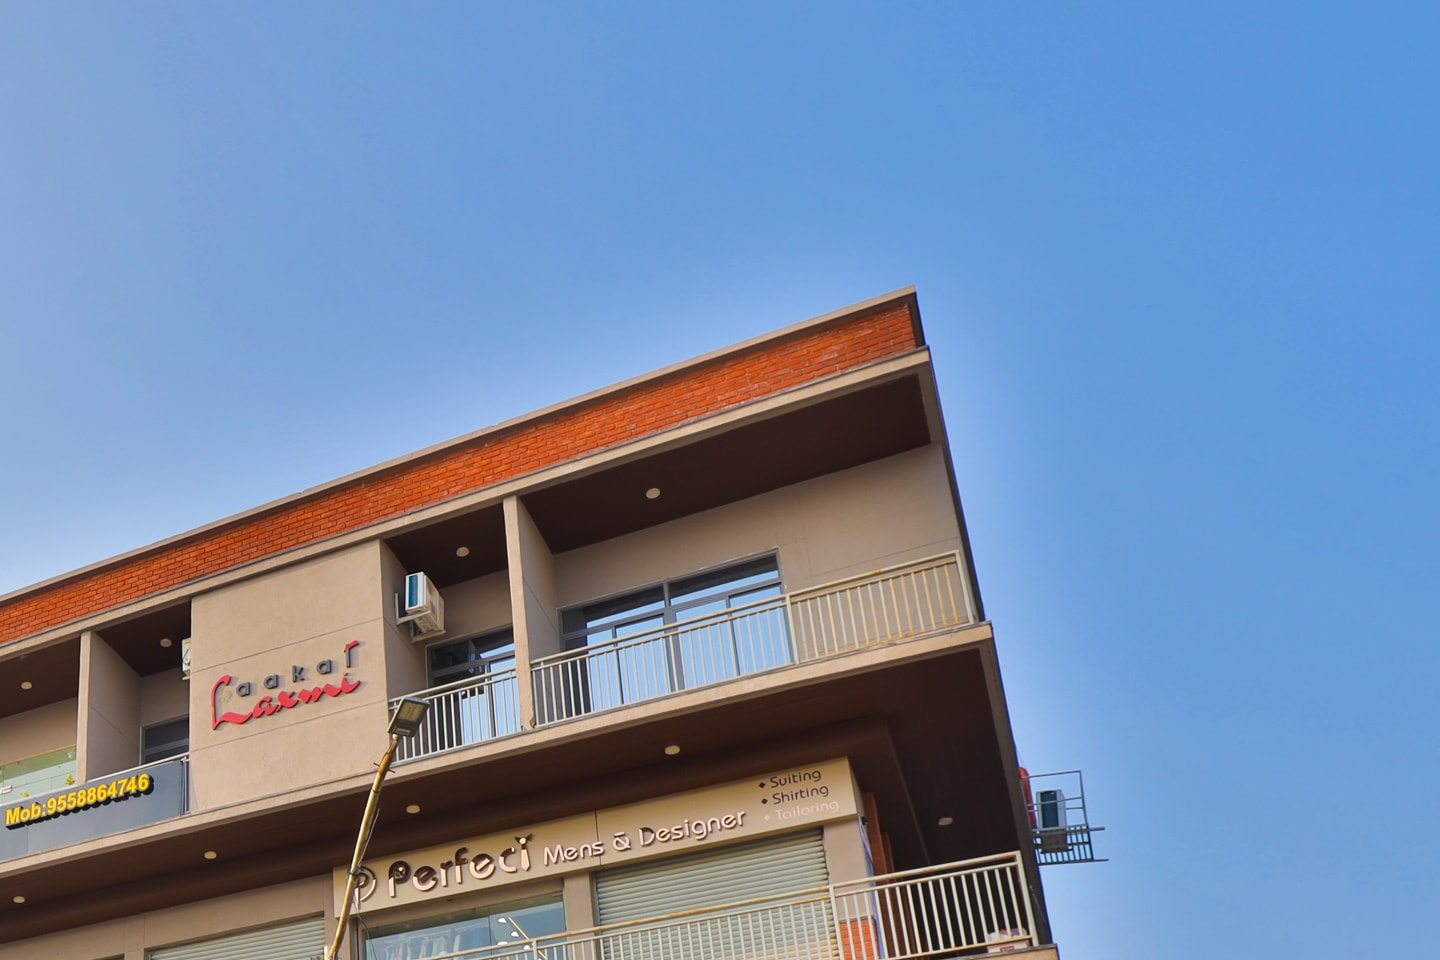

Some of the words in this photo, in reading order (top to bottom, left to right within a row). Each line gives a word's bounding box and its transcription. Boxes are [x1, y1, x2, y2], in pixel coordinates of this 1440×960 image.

[211, 672, 360, 730] Laxmi
[770, 770, 822, 788] Suiting
[772, 786, 829, 805] Shirting
[776, 801, 839, 820] Tailoring
[543, 838, 605, 867] Mens
[612, 831, 633, 852] &
[639, 810, 747, 847] Designer
